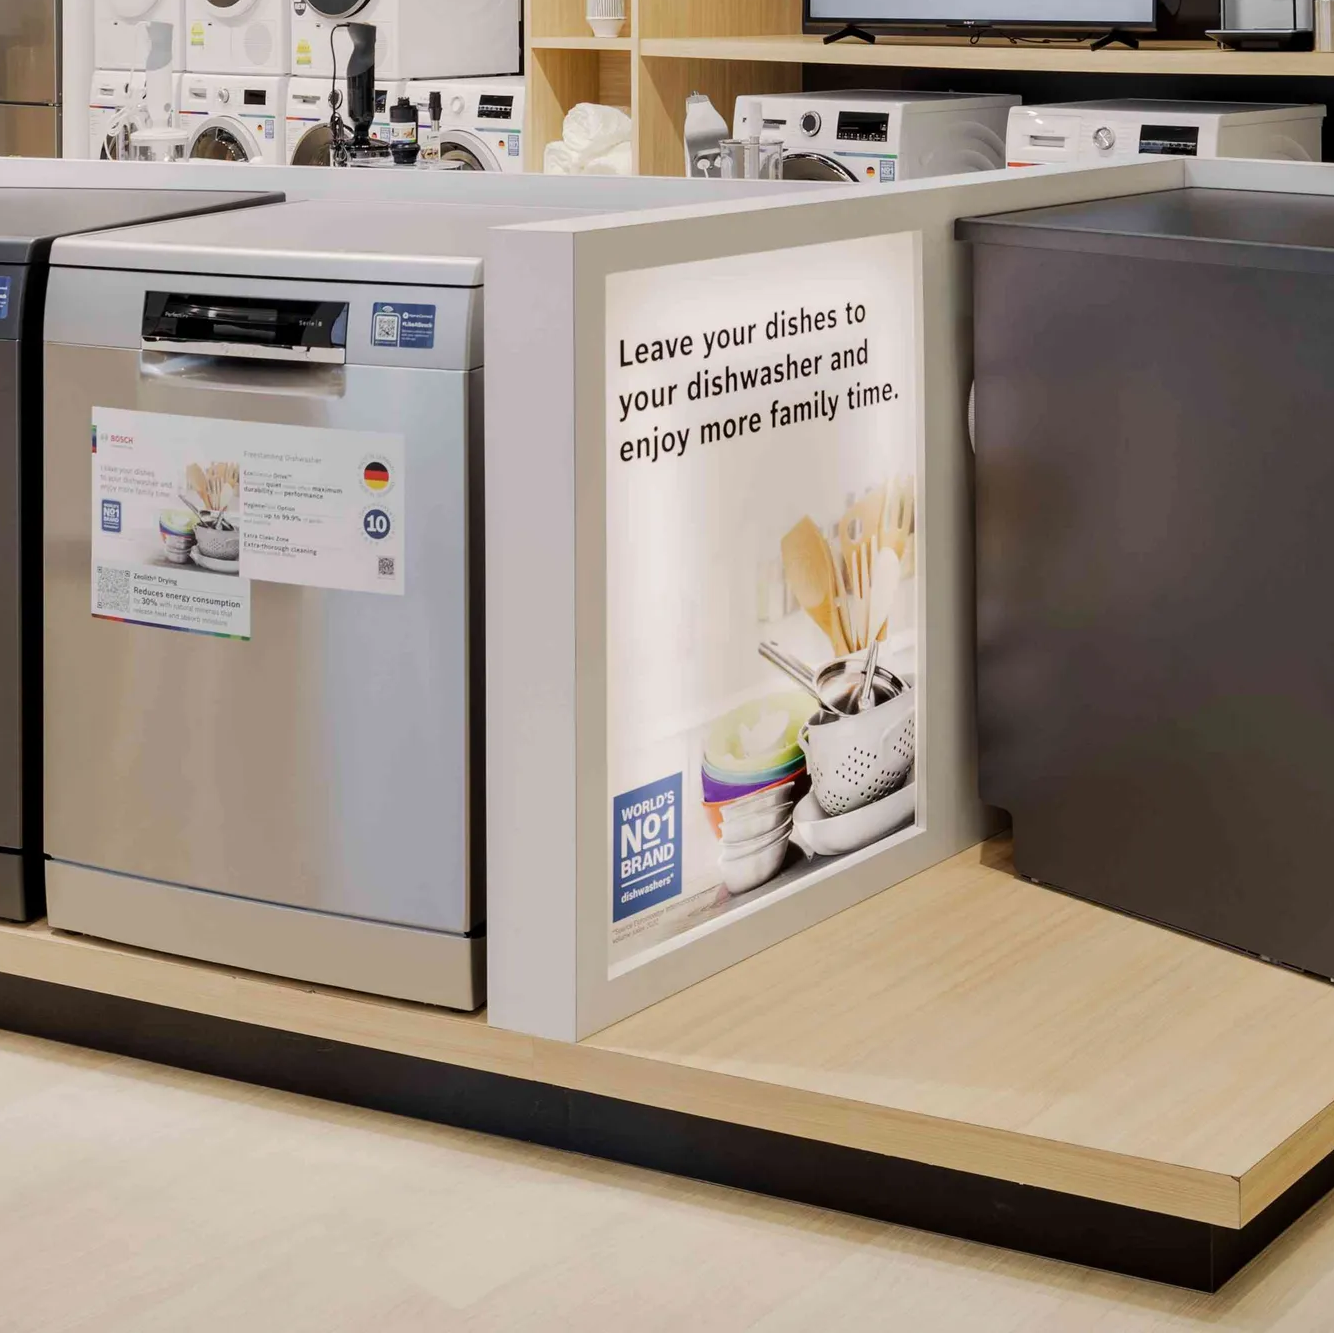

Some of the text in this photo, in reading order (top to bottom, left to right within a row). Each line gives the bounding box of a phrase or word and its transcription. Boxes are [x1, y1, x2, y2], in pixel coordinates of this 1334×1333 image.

[620, 302, 866, 368] Leave your dishes to
[619, 338, 869, 423] your dishwasher and
[620, 381, 899, 463] enjoy more family time.
[110, 435, 134, 444] BOSCH
[243, 450, 322, 464] Freestanding Dishwasher
[243, 486, 324, 500] durability performance
[312, 486, 343, 495] maximum
[281, 513, 301, 522] 99.9%
[366, 515, 387, 533] 10
[290, 545, 317, 556] cleaning
[158, 577, 178, 586] Drying
[133, 587, 241, 608] Reduces energy consumption
[141, 598, 158, 606] 30%
[195, 606, 219, 615] minerals
[621, 790, 675, 822] WORLD'S
[621, 842, 675, 879] BRAND
